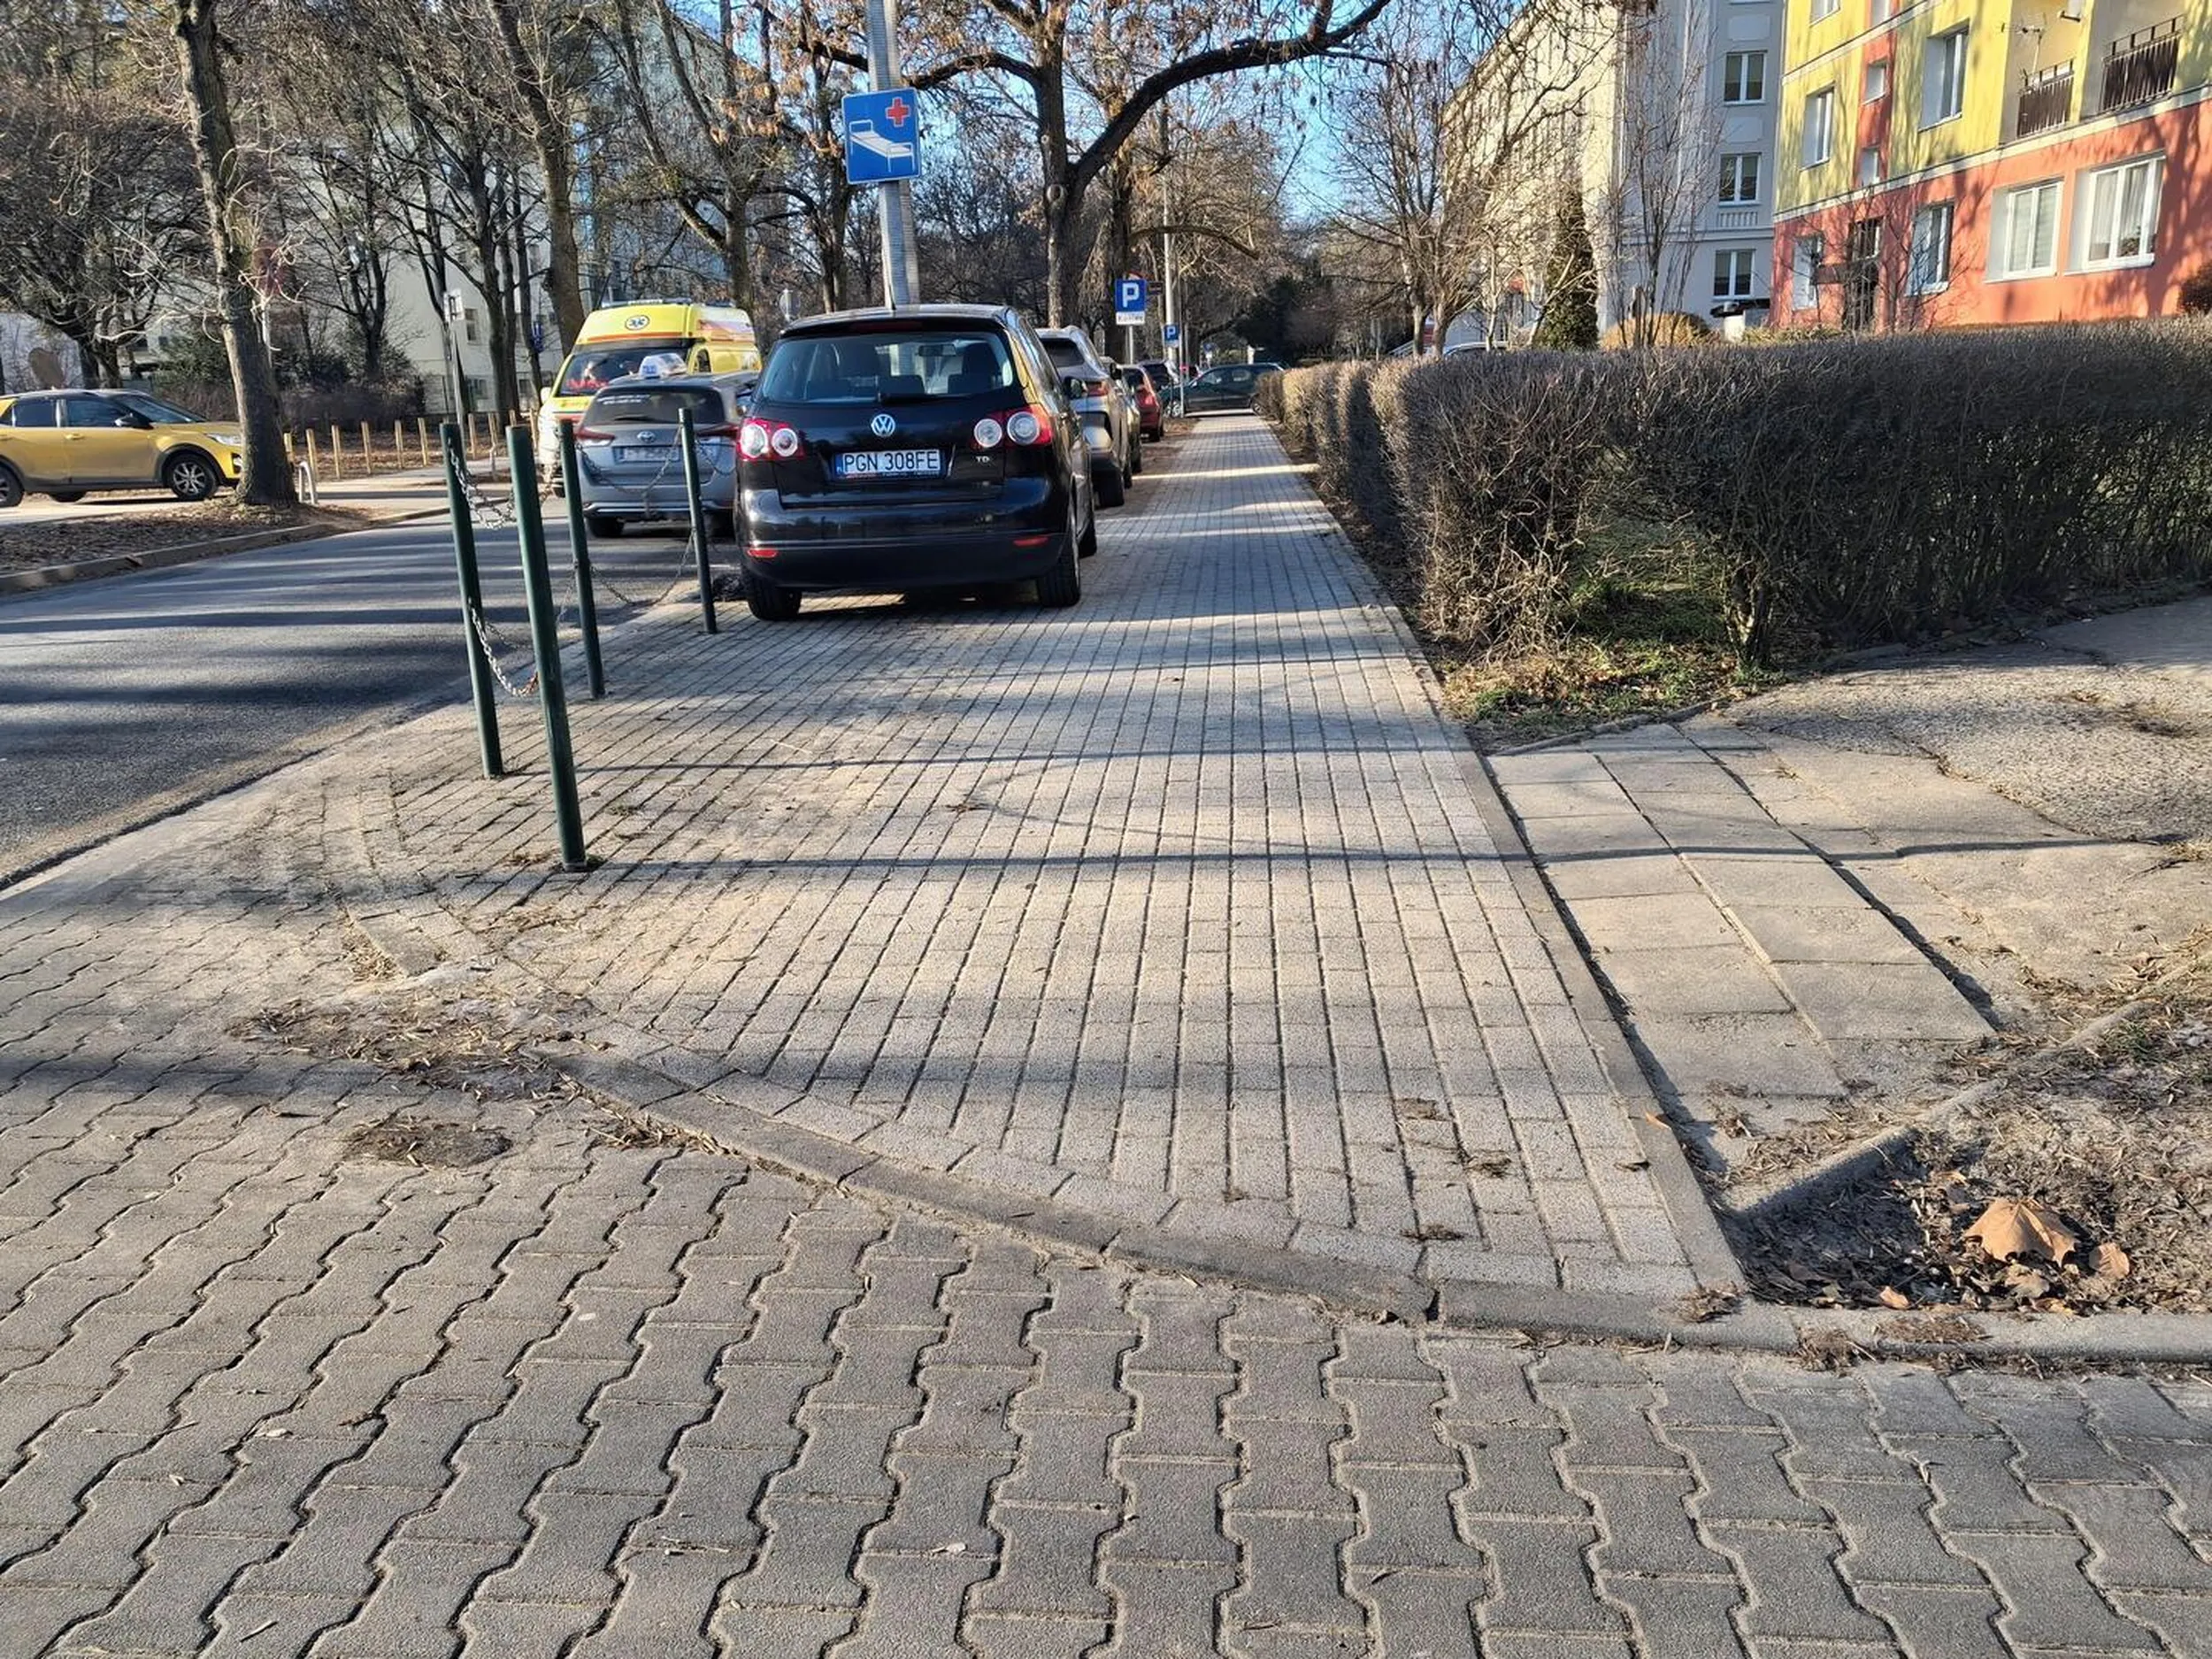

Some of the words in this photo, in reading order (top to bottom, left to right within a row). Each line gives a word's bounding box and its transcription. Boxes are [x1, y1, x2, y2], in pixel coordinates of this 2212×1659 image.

[1122, 282, 1140, 308] P
[1167, 326, 1176, 339] P
[872, 414, 894, 435] VW
[844, 454, 879, 472] PGN
[884, 451, 939, 470] 308FE
